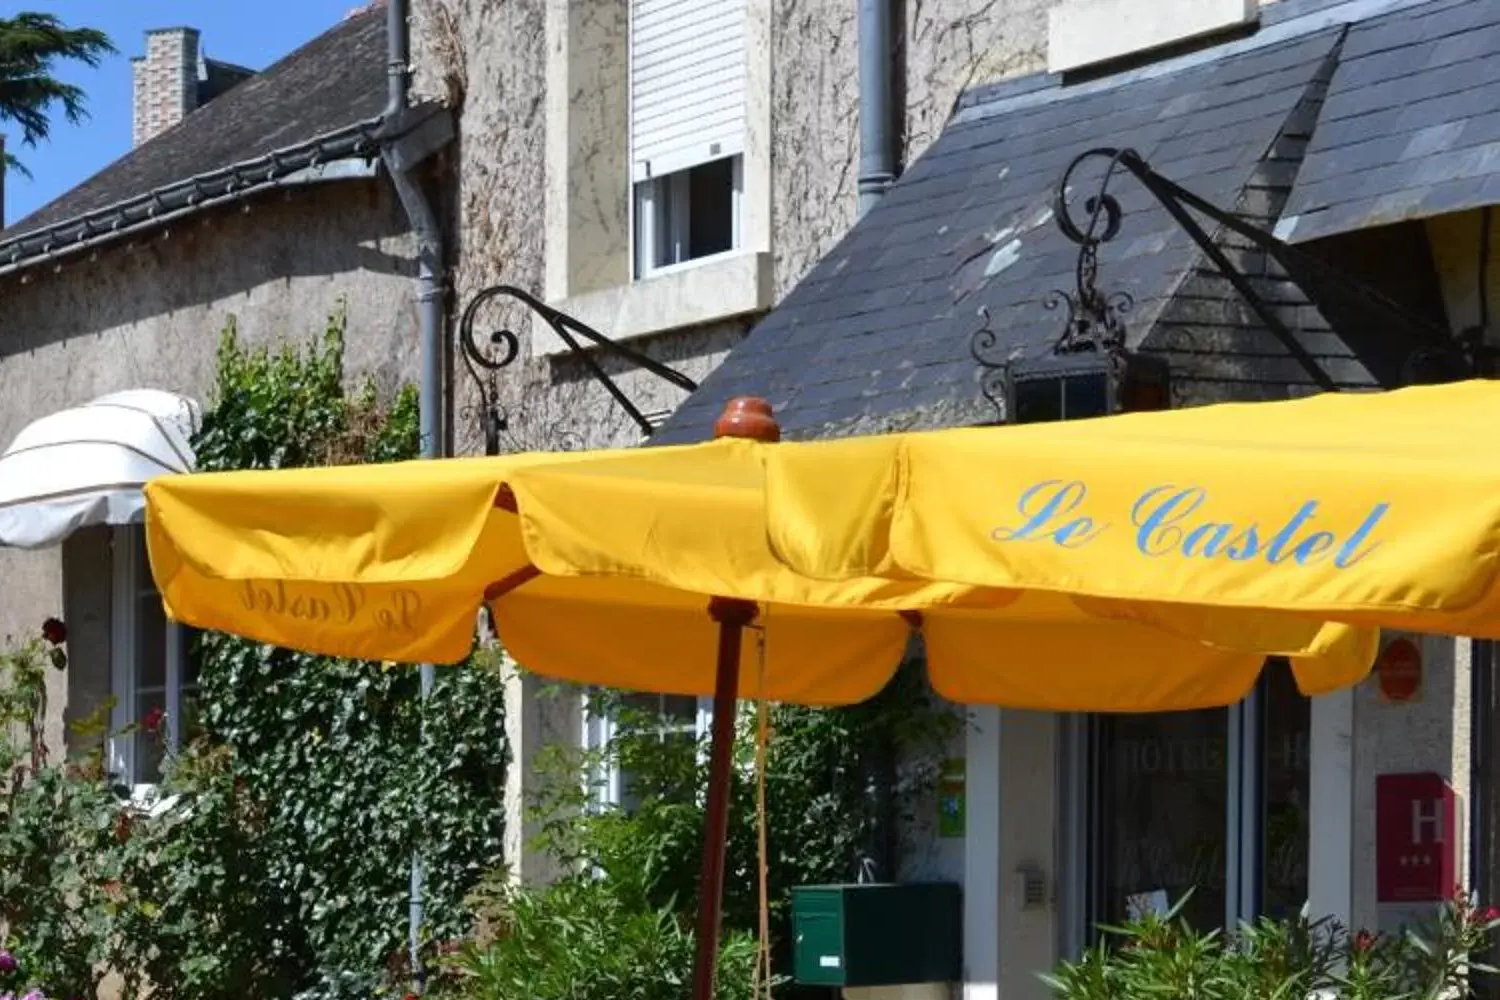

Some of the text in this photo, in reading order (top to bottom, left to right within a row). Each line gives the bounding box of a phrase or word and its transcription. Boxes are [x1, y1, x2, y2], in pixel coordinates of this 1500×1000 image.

[990, 478, 1390, 570] Le Castel
[1411, 797, 1446, 845] H
